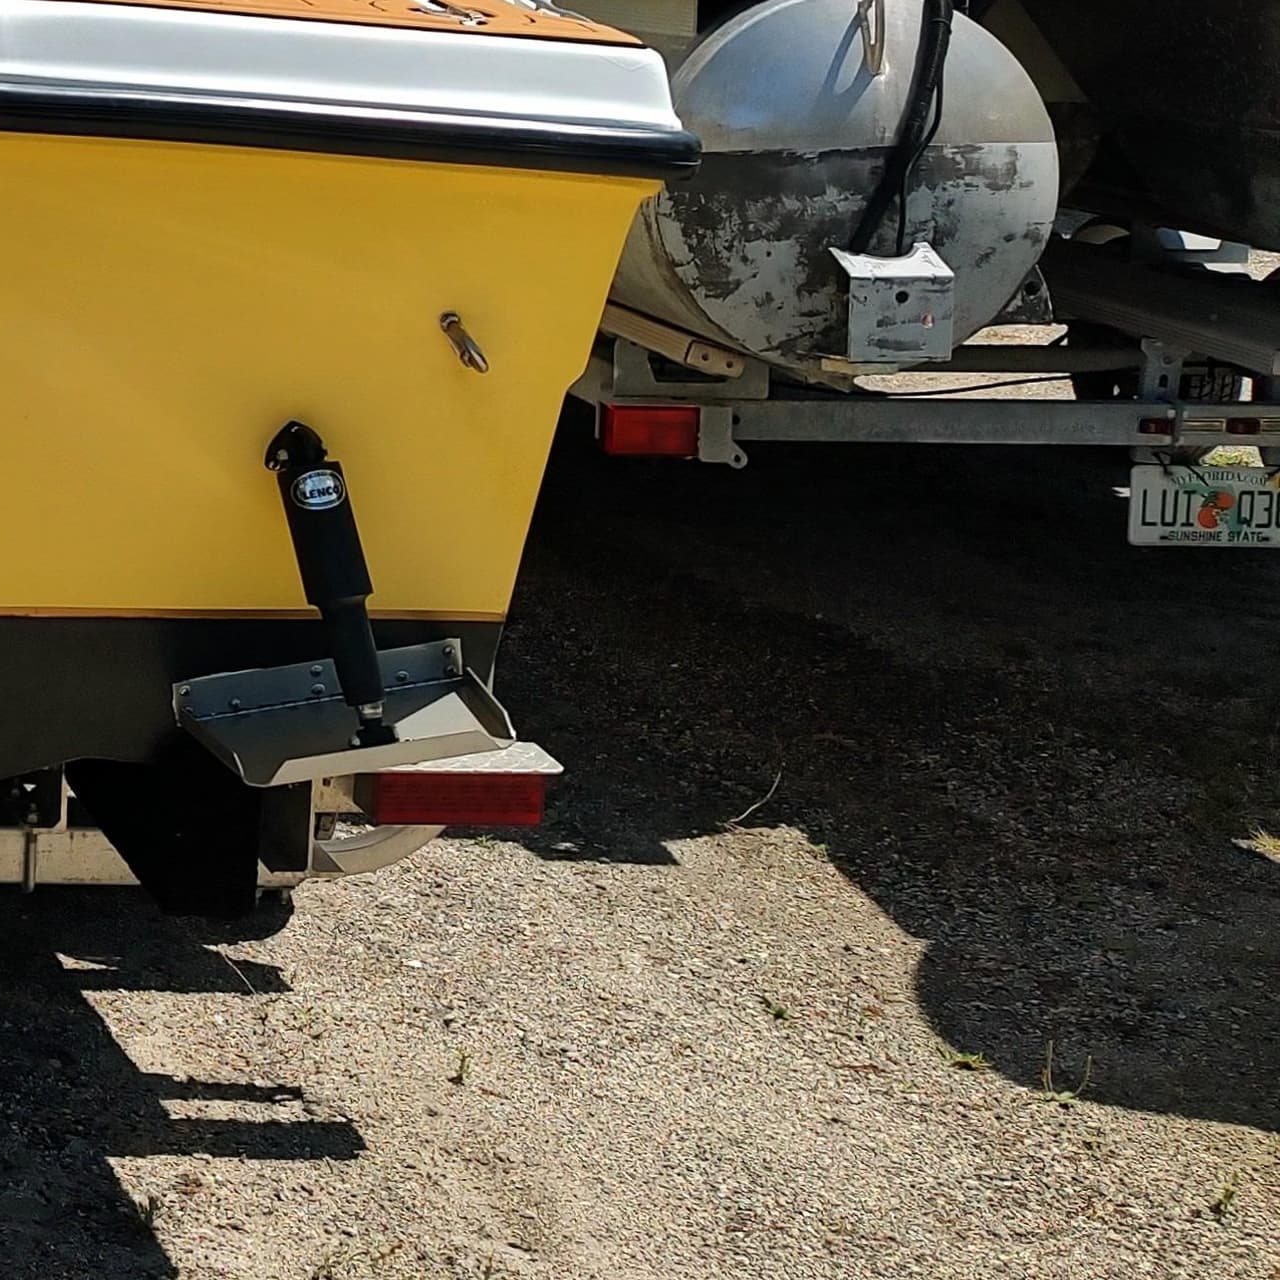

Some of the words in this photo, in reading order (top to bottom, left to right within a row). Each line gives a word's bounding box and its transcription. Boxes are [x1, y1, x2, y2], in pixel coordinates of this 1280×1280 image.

[303, 485, 339, 500] LENCO
[1141, 489, 1196, 527] LUI
[1168, 531, 1222, 542] SUNSHINE
[1227, 531, 1263, 542] STATE
